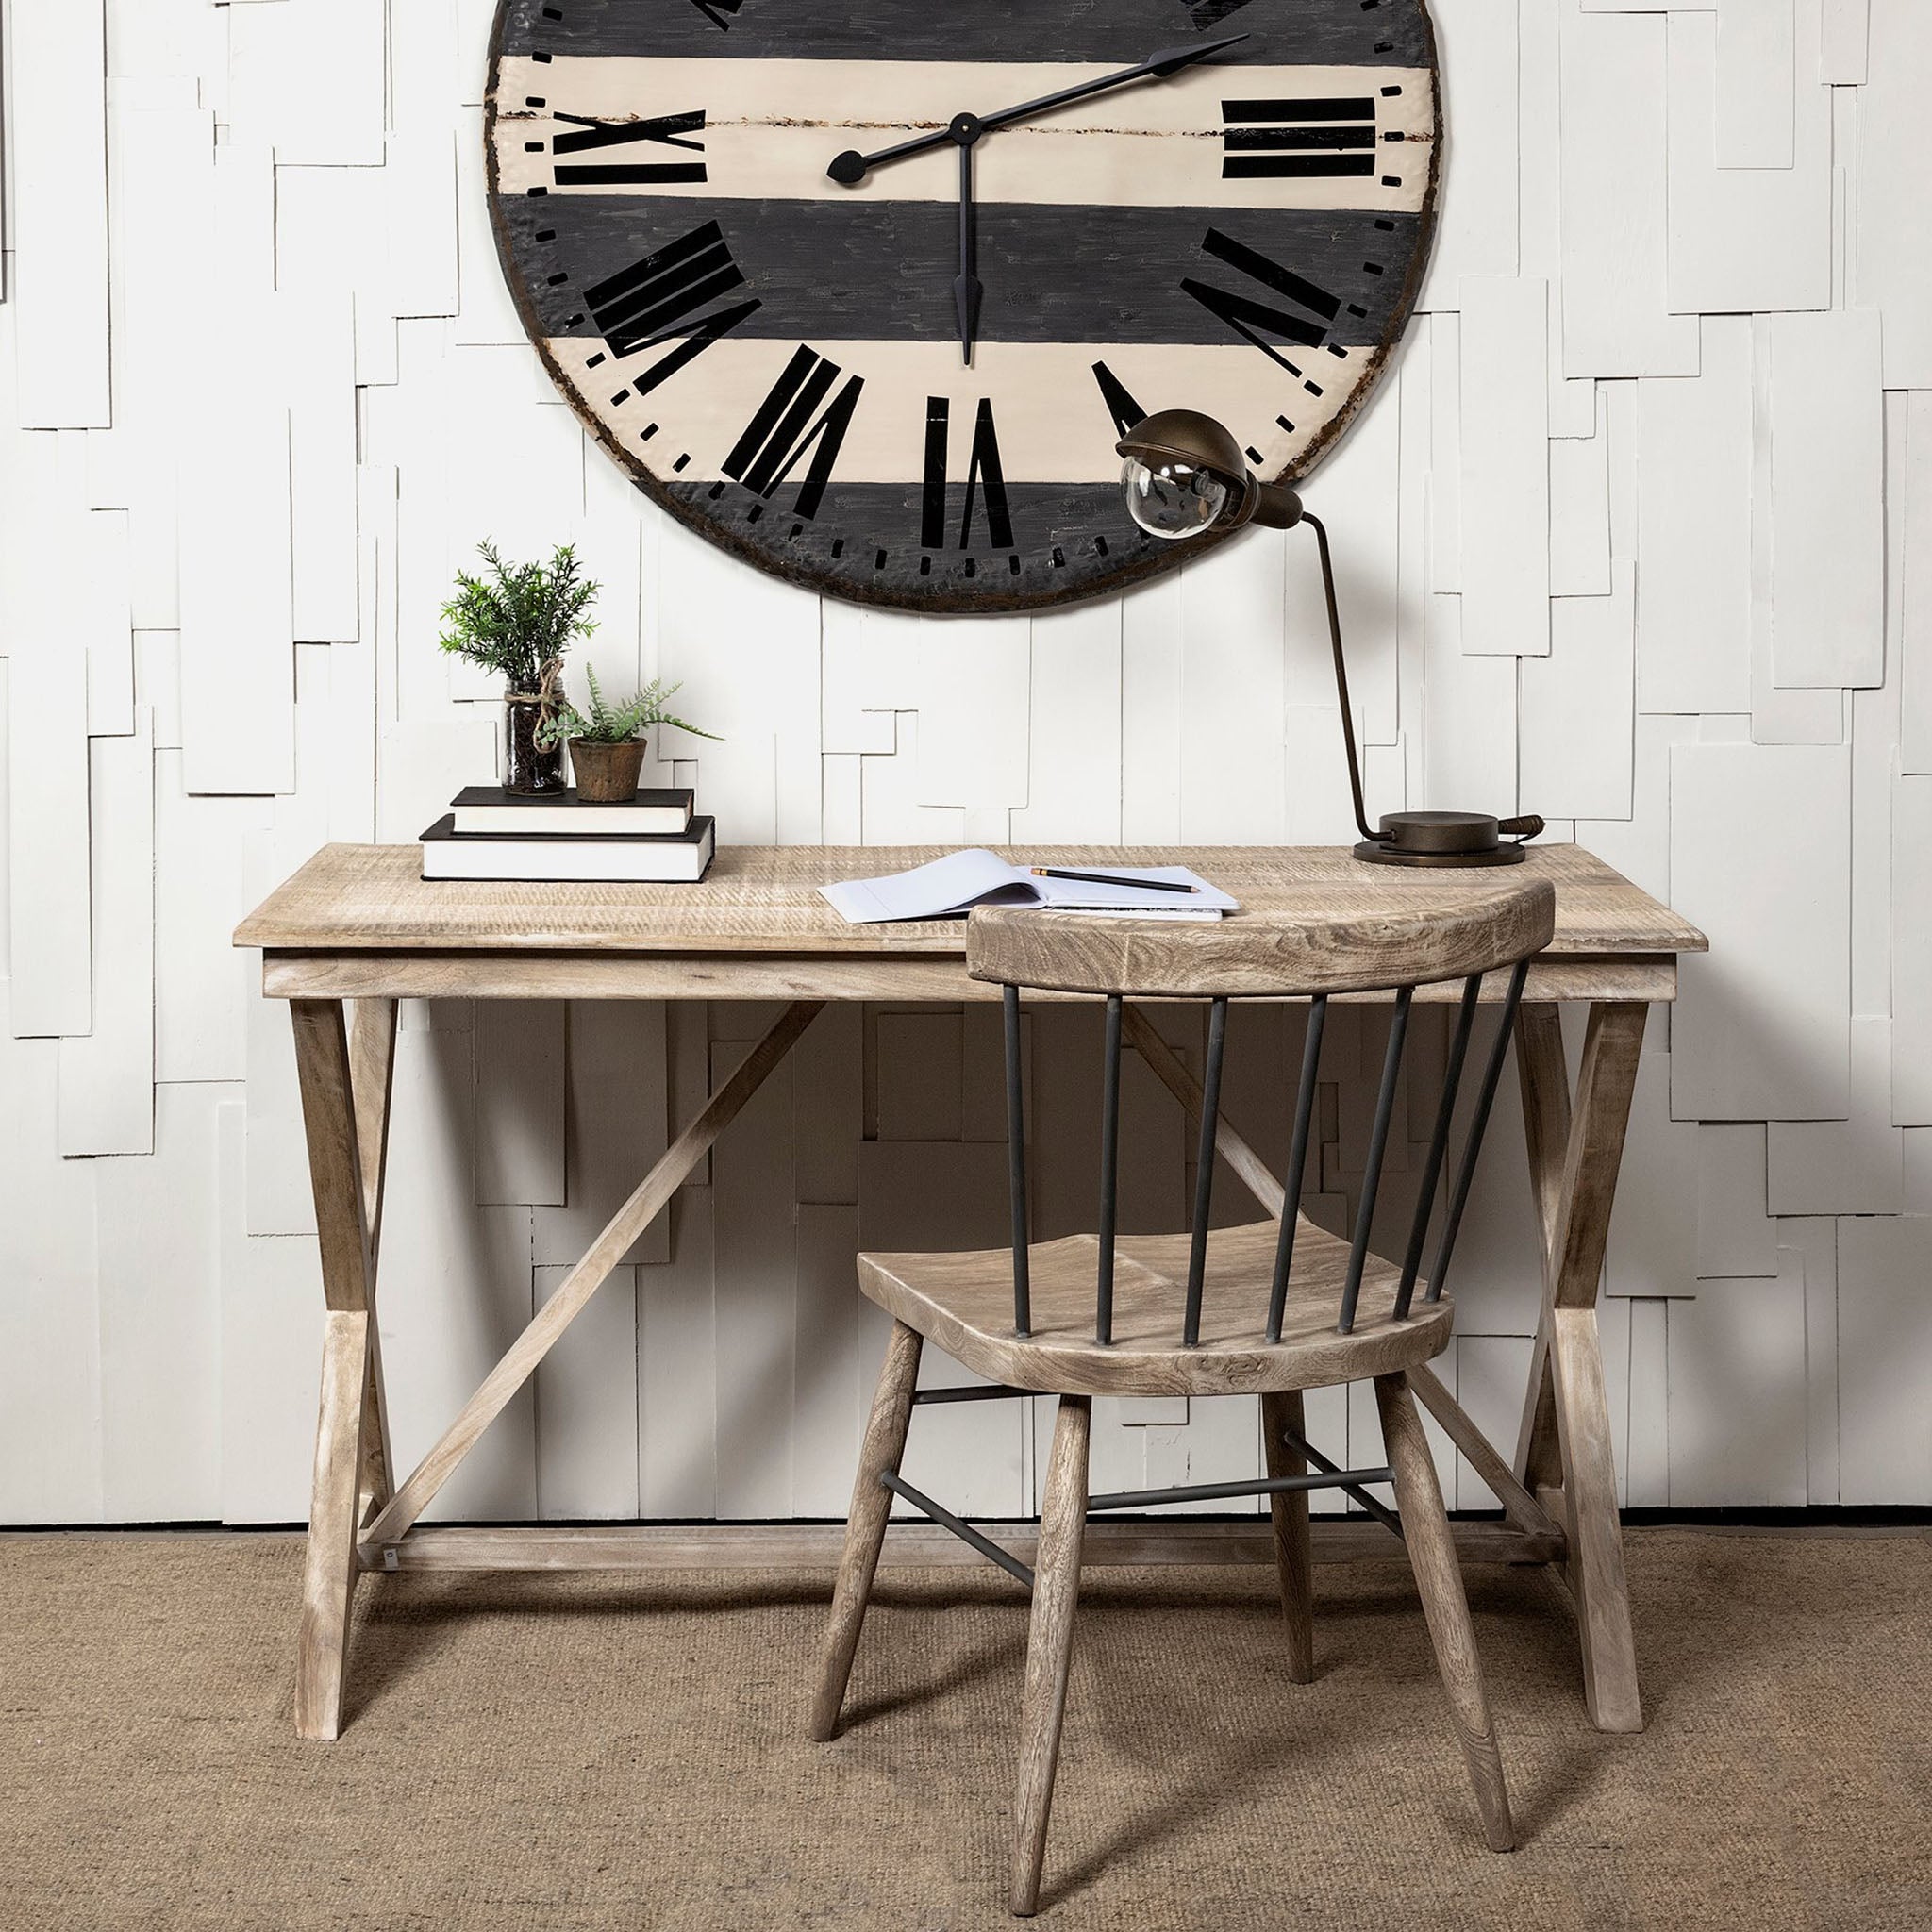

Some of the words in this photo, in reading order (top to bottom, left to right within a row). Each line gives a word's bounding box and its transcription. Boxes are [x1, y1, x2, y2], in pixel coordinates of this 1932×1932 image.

[553, 109, 708, 185] IX
[1221, 97, 1376, 179] III
[583, 219, 763, 396] VIII
[1179, 227, 1341, 378] IV
[720, 342, 865, 521] VII
[921, 395, 1015, 550] VI
